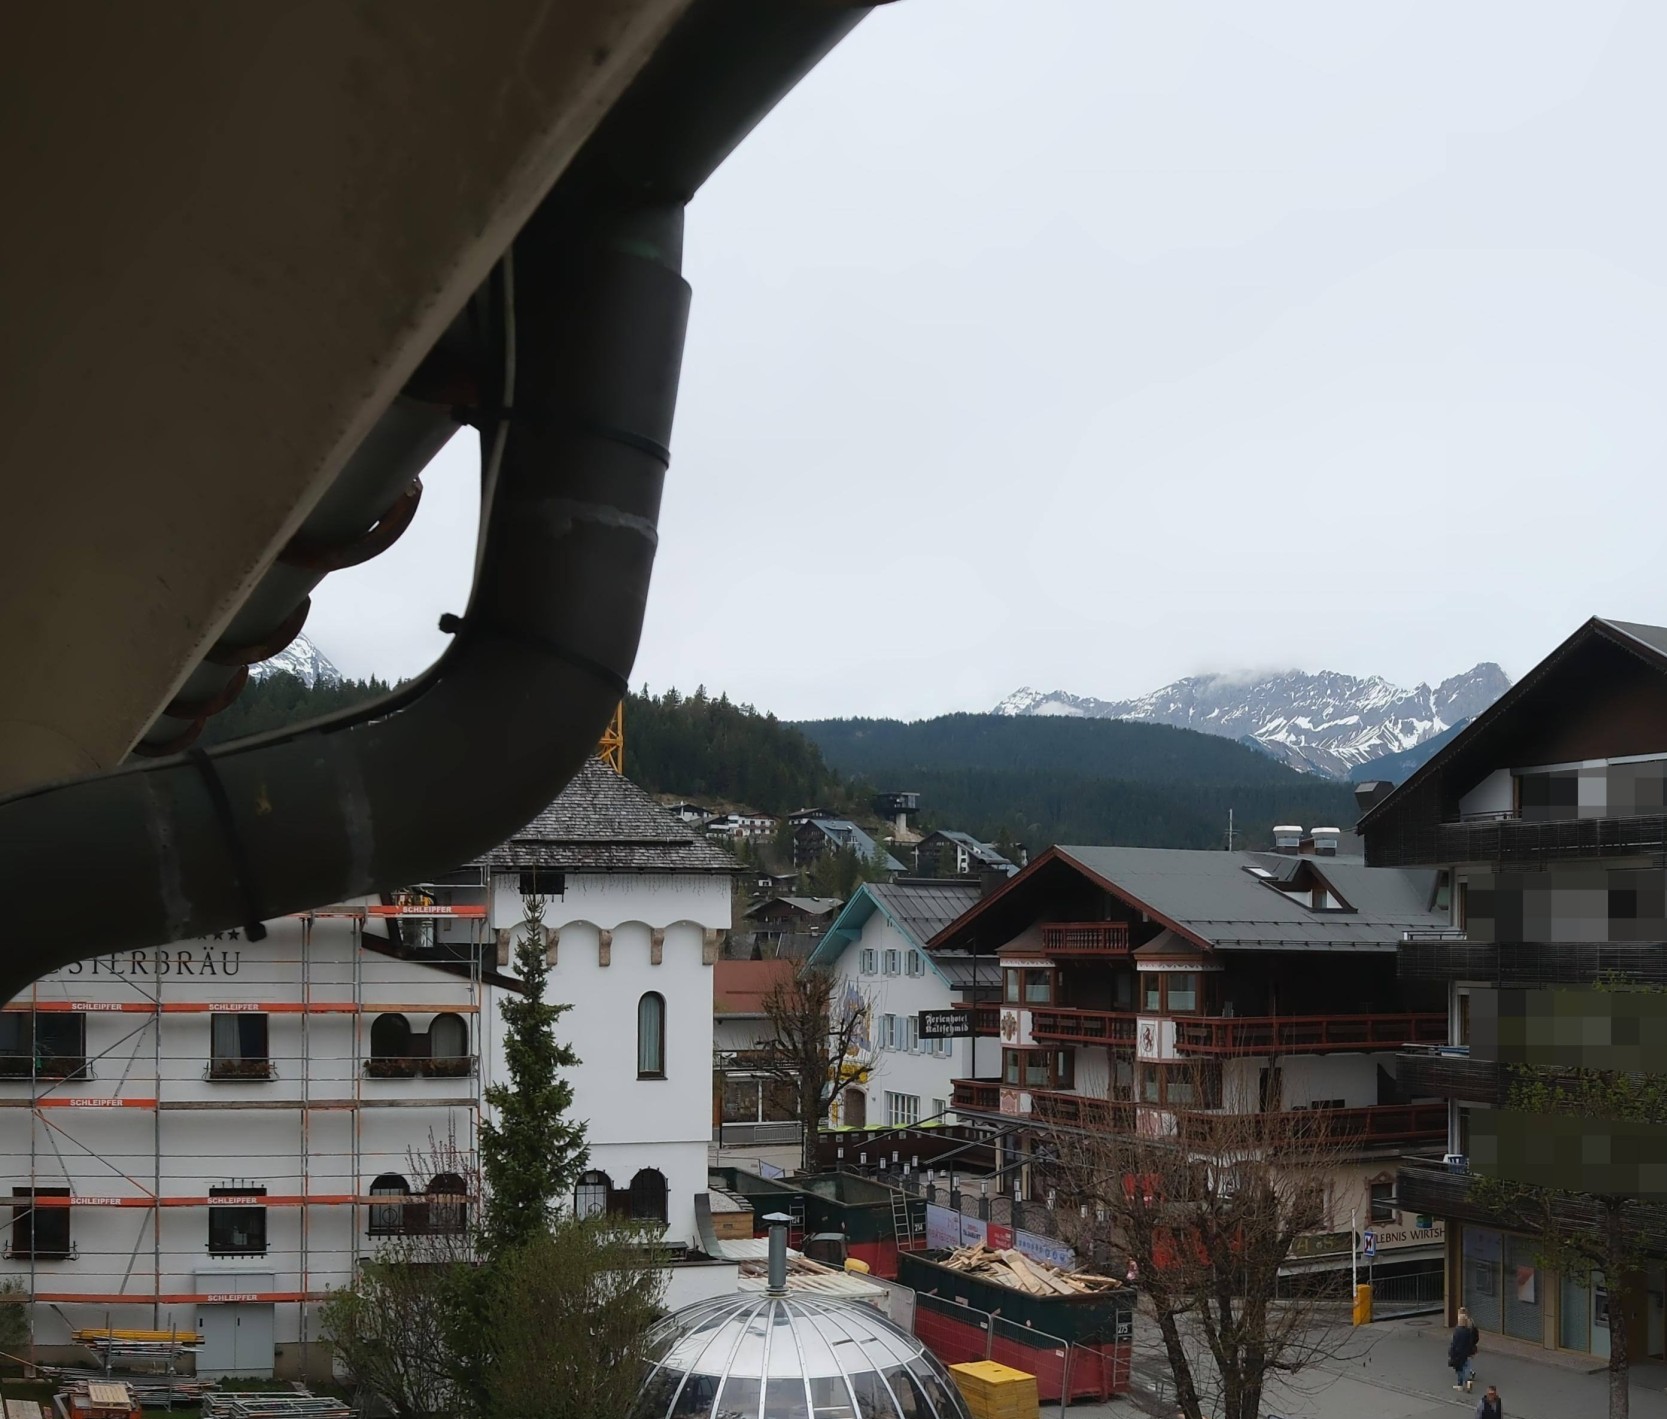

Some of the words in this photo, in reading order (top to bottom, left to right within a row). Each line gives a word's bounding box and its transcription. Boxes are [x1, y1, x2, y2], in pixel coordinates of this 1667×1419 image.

[402, 905, 452, 914] SCHLEIPFER
[71, 1002, 123, 1011] SCHLEIPFER
[208, 1003, 260, 1012] SCHLEIPFER
[70, 1098, 123, 1107] SCHLEIPFER
[70, 1197, 122, 1205] SCHLEIPFER
[207, 1196, 258, 1204] SCHLEIPFER
[1375, 1231, 1407, 1244] LEBNIS
[207, 1294, 258, 1302] SCHLEIPFER
